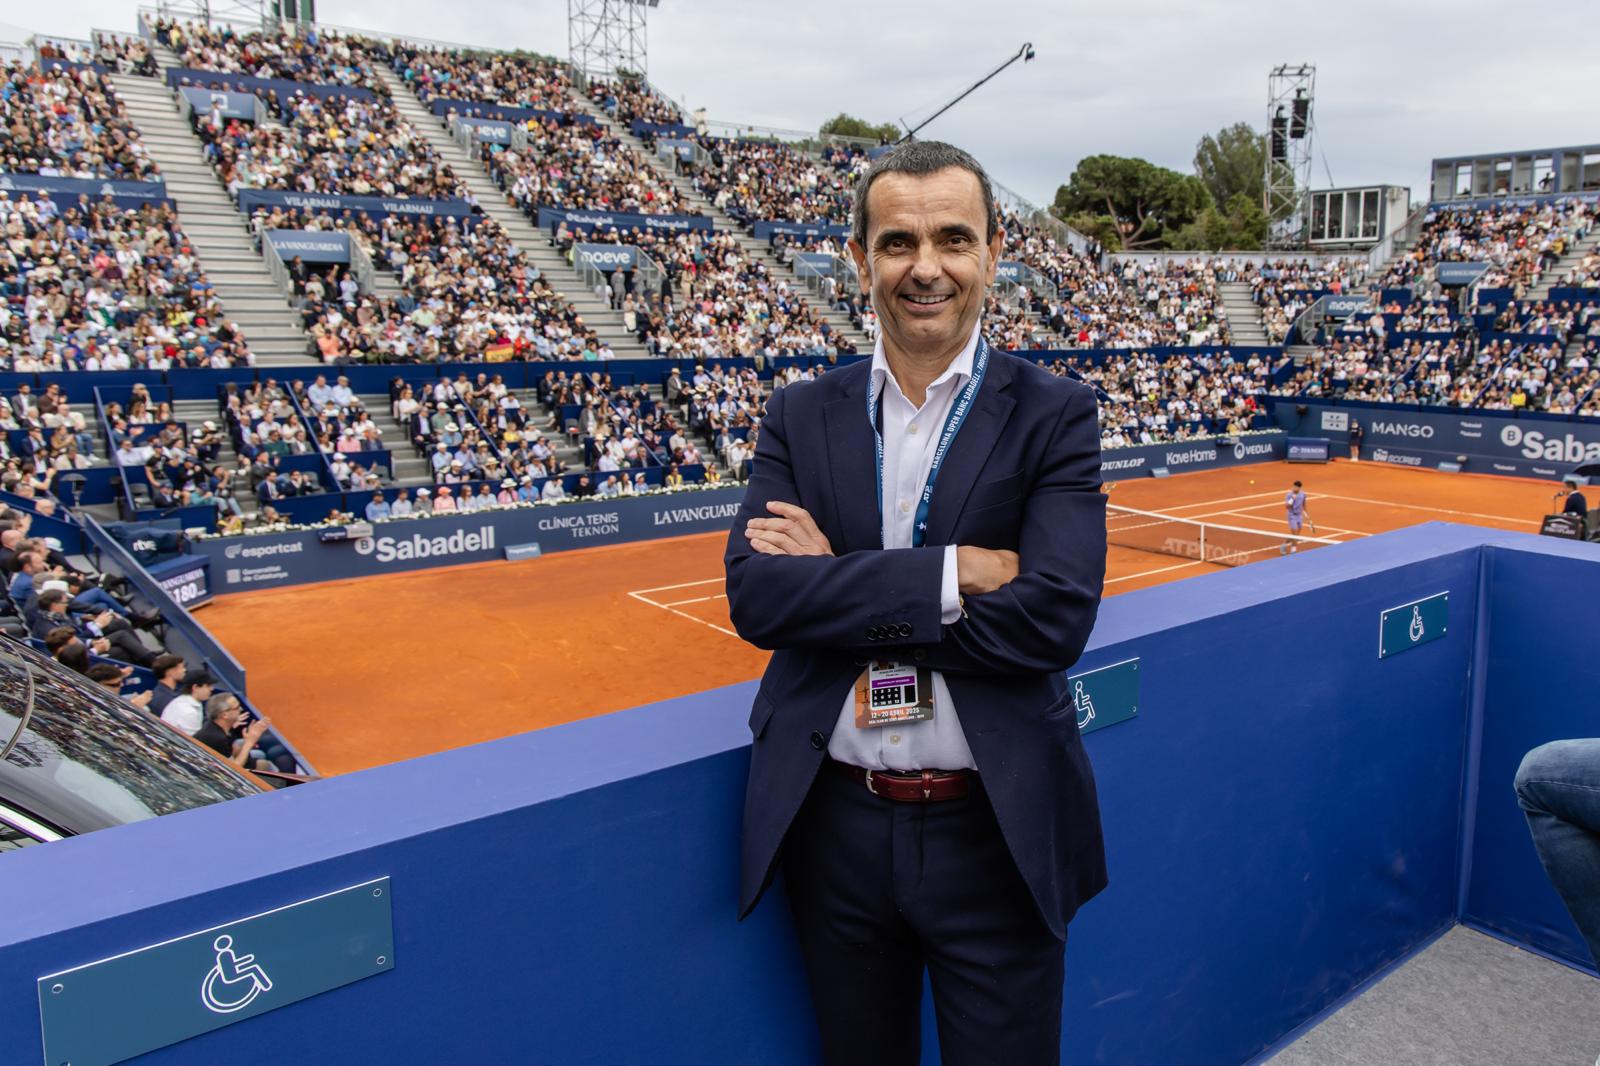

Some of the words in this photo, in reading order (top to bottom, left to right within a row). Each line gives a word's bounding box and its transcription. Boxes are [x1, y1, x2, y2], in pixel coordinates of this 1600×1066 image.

[462, 123, 507, 139] meve
[284, 196, 340, 209] VILARNAU
[382, 202, 434, 214] VILARNAU
[581, 251, 631, 264] moeve
[932, 432, 952, 469] BARCELONA
[947, 415, 961, 432] OPEN
[955, 399, 969, 417] BANC
[963, 372, 981, 400] SABADELL
[1372, 421, 1434, 438] MANGO
[1245, 443, 1272, 455] VEOLIA
[1100, 457, 1145, 471] DUNLOP
[538, 515, 585, 531] CLÍNICA
[586, 512, 619, 525] TENIS
[654, 511, 671, 526] LA
[571, 524, 620, 538] TEKNON
[242, 542, 303, 558] esportcat
[375, 525, 495, 562] Sabadell
[1162, 537, 1200, 556] ATP
[1205, 544, 1249, 564] TOUR
[173, 582, 198, 603] 180
